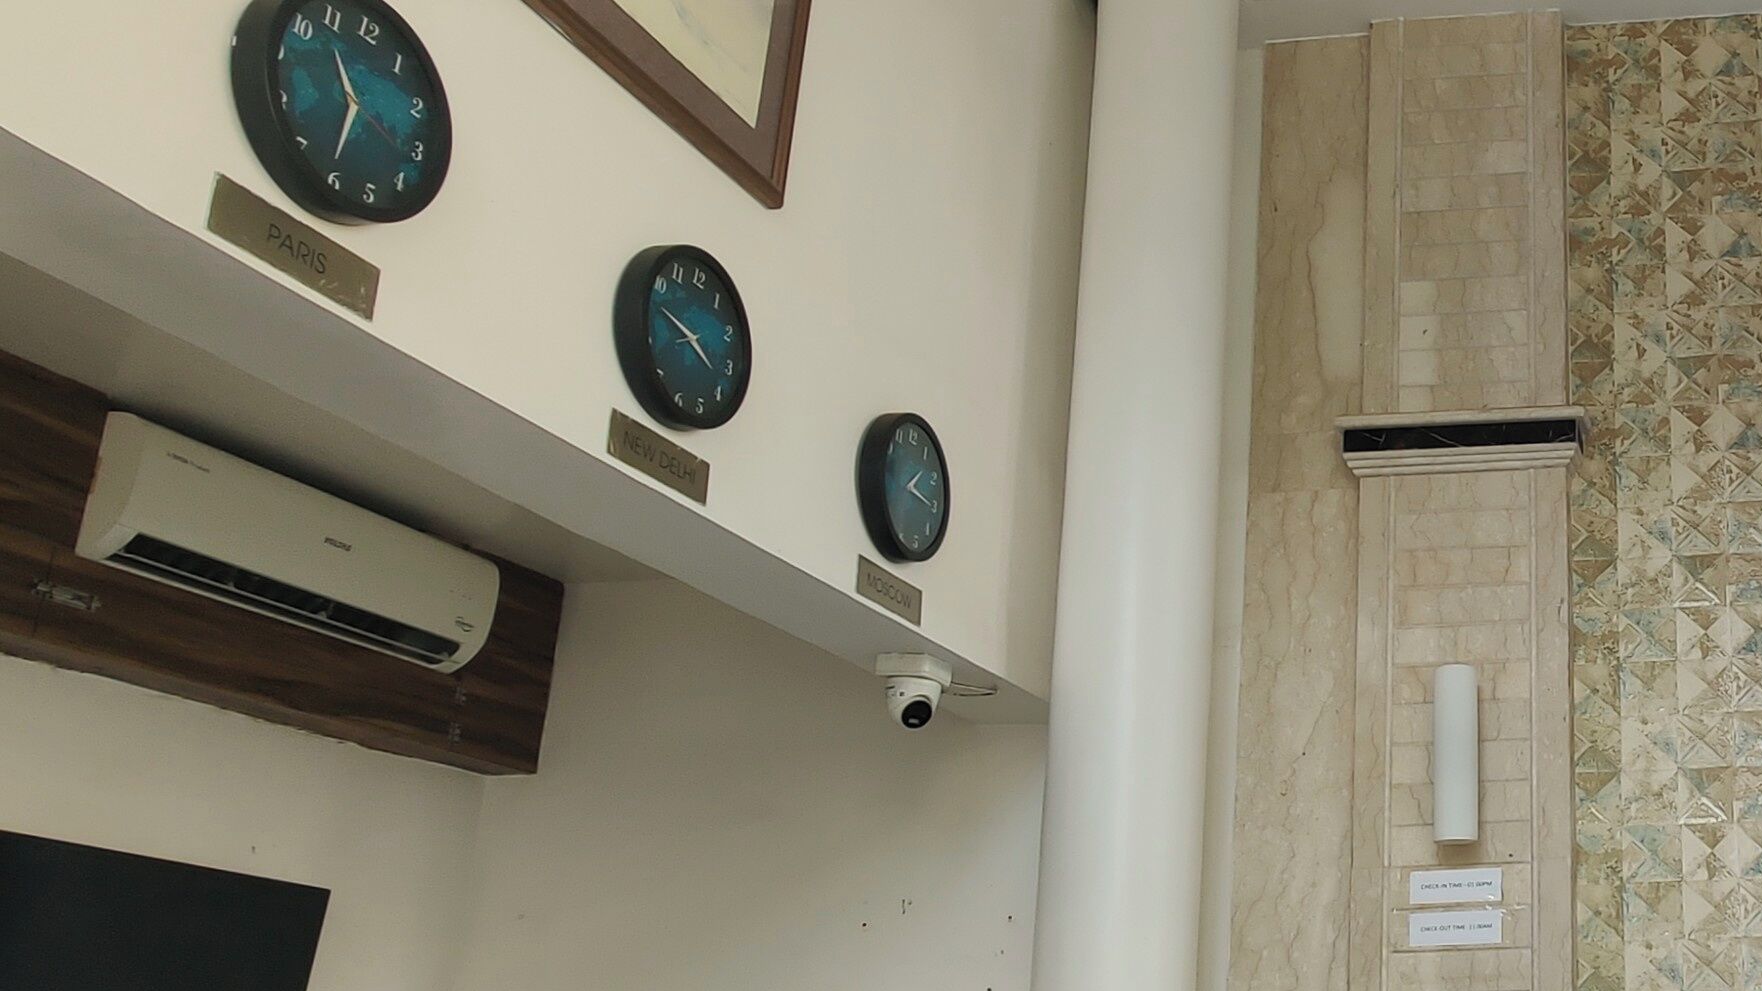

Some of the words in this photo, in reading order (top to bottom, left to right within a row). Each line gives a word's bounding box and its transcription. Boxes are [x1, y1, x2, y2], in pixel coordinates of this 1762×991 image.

[291, 12, 314, 41] 10
[321, 4, 342, 33] 11
[356, 15, 381, 45] 12
[392, 52, 402, 75] 1
[409, 97, 424, 119] 2
[411, 141, 424, 161] 3
[327, 171, 341, 191] 6
[393, 171, 406, 192] 4
[362, 183, 377, 203] 5
[266, 222, 328, 274] PARIS
[671, 262, 684, 285] 11
[692, 266, 707, 290] 12
[654, 274, 667, 295] 10
[713, 292, 721, 310] 1
[723, 325, 734, 342] 2
[725, 359, 734, 376] 3
[695, 397, 705, 414] 5
[908, 428, 918, 446] 12
[623, 430, 656, 463] NEW
[659, 450, 697, 484] DELHI
[867, 571, 913, 610] MOSCOW
